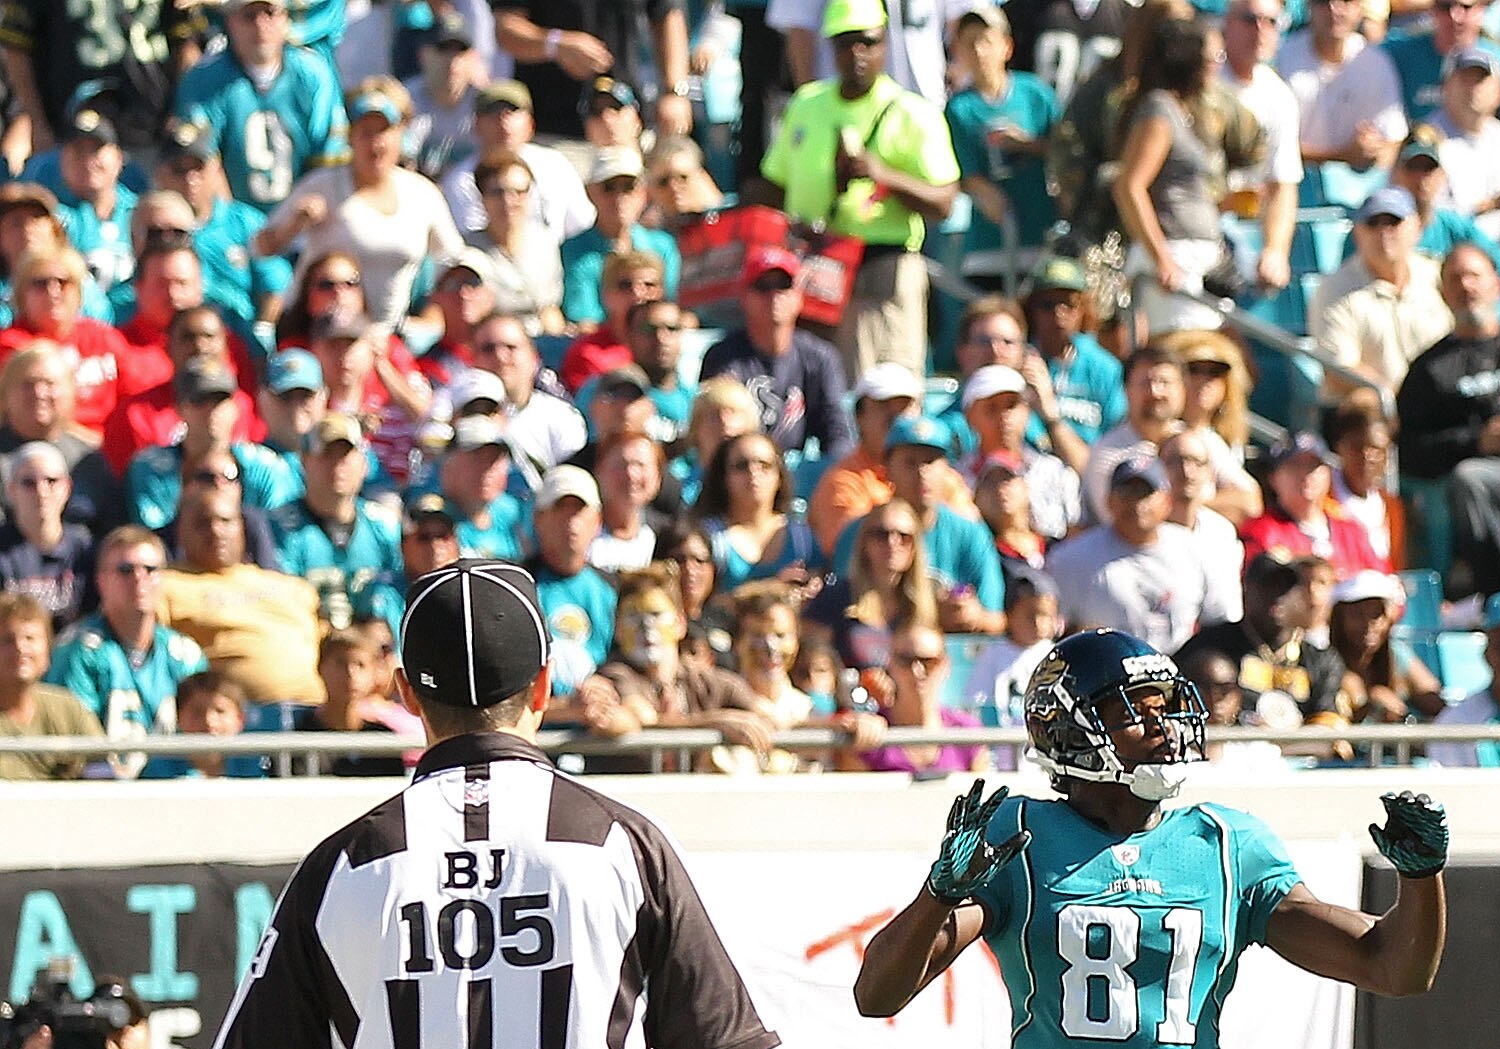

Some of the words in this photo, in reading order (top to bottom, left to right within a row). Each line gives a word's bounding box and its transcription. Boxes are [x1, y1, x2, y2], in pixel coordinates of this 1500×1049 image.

[444, 849, 506, 890] BJ
[401, 893, 555, 974] 105
[1056, 903, 1203, 1045] 81
